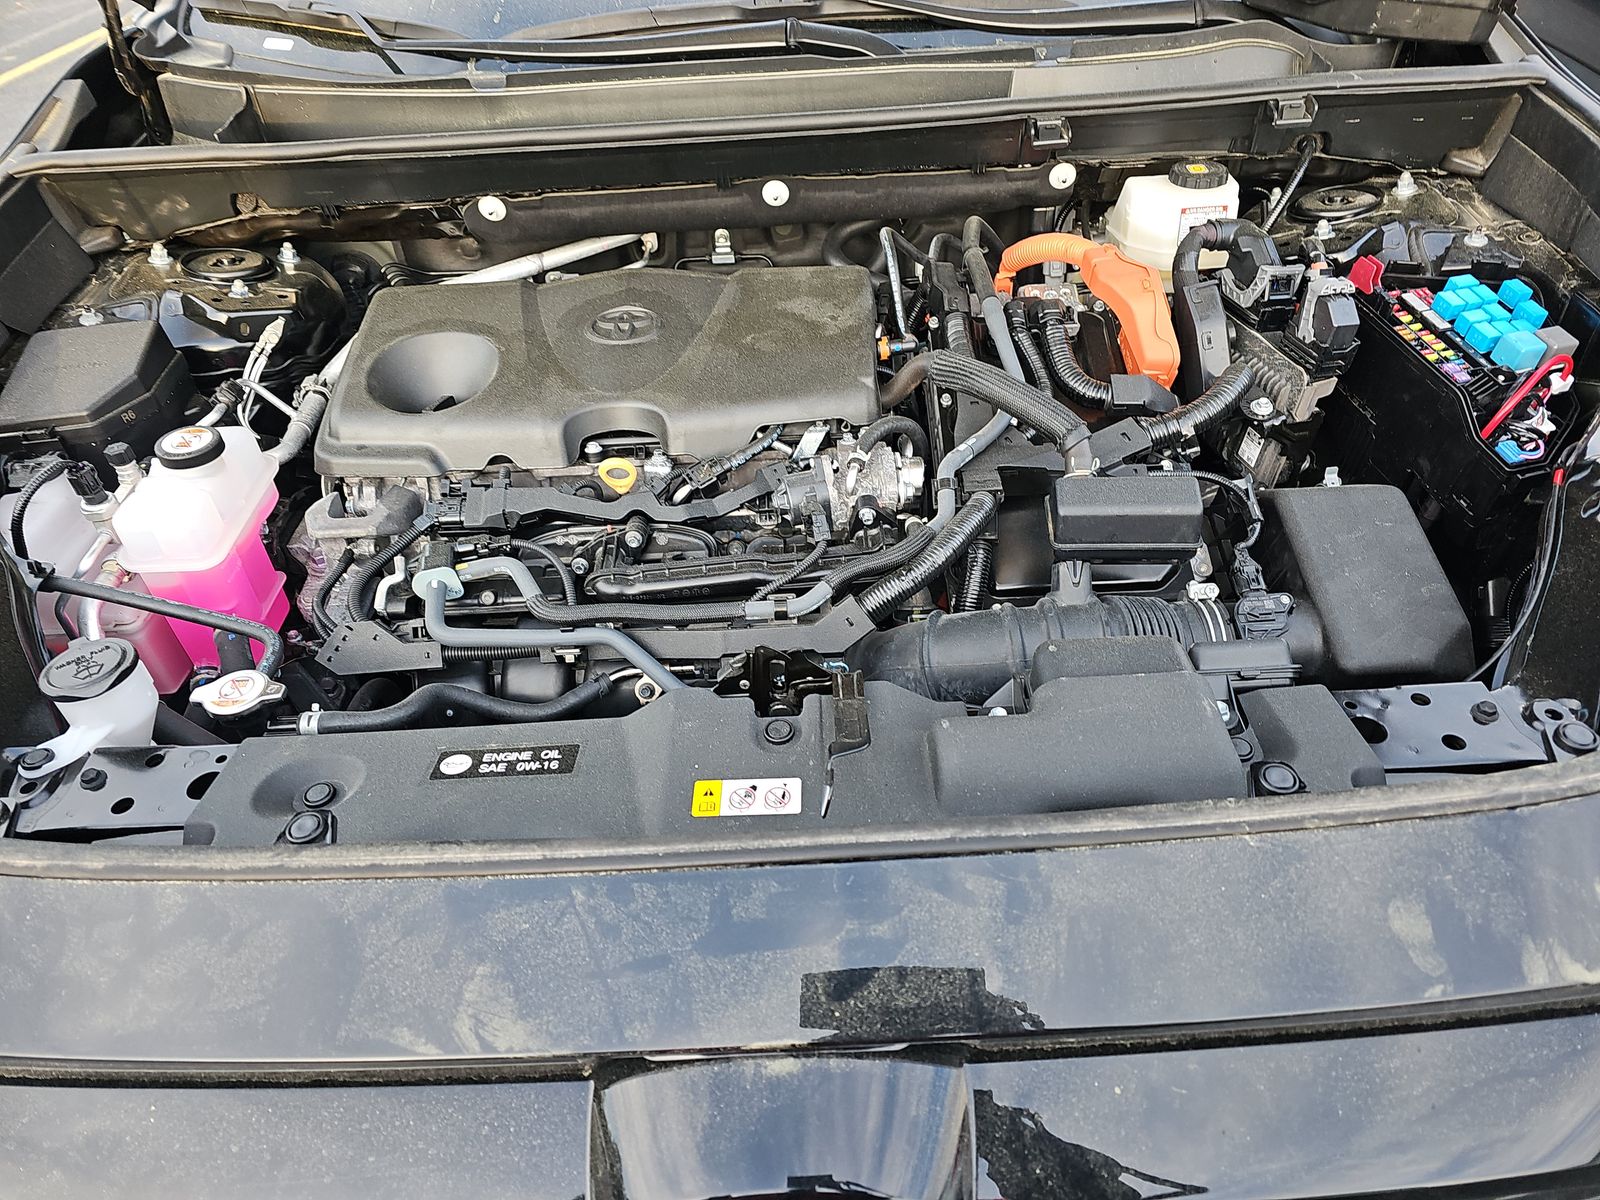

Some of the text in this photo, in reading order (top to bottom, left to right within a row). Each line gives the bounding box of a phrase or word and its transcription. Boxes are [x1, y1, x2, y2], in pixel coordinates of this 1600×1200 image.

[482, 750, 562, 762] ENGINE OIL
[478, 761, 559, 773] SAE 0W-16
